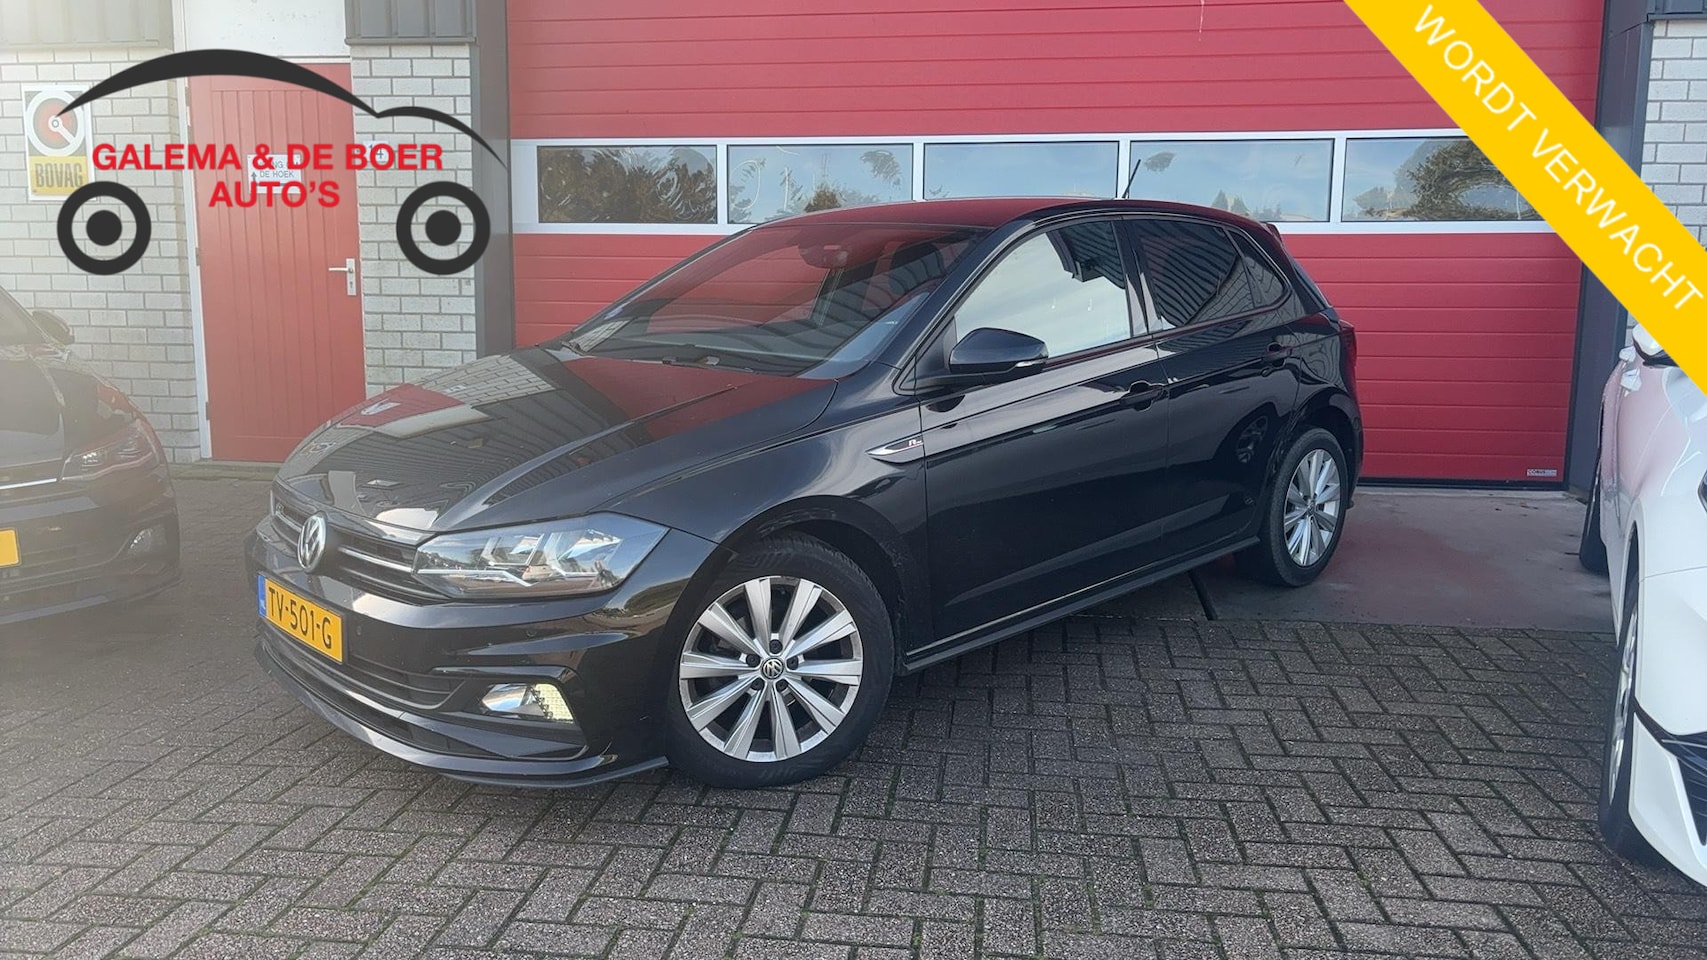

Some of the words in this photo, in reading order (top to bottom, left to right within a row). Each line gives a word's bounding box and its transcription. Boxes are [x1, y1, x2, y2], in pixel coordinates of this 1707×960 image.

[34, 162, 83, 188] BOVAG
[260, 170, 270, 178] DE
[272, 170, 294, 178] HOEK
[268, 587, 332, 649] TV-501-G
